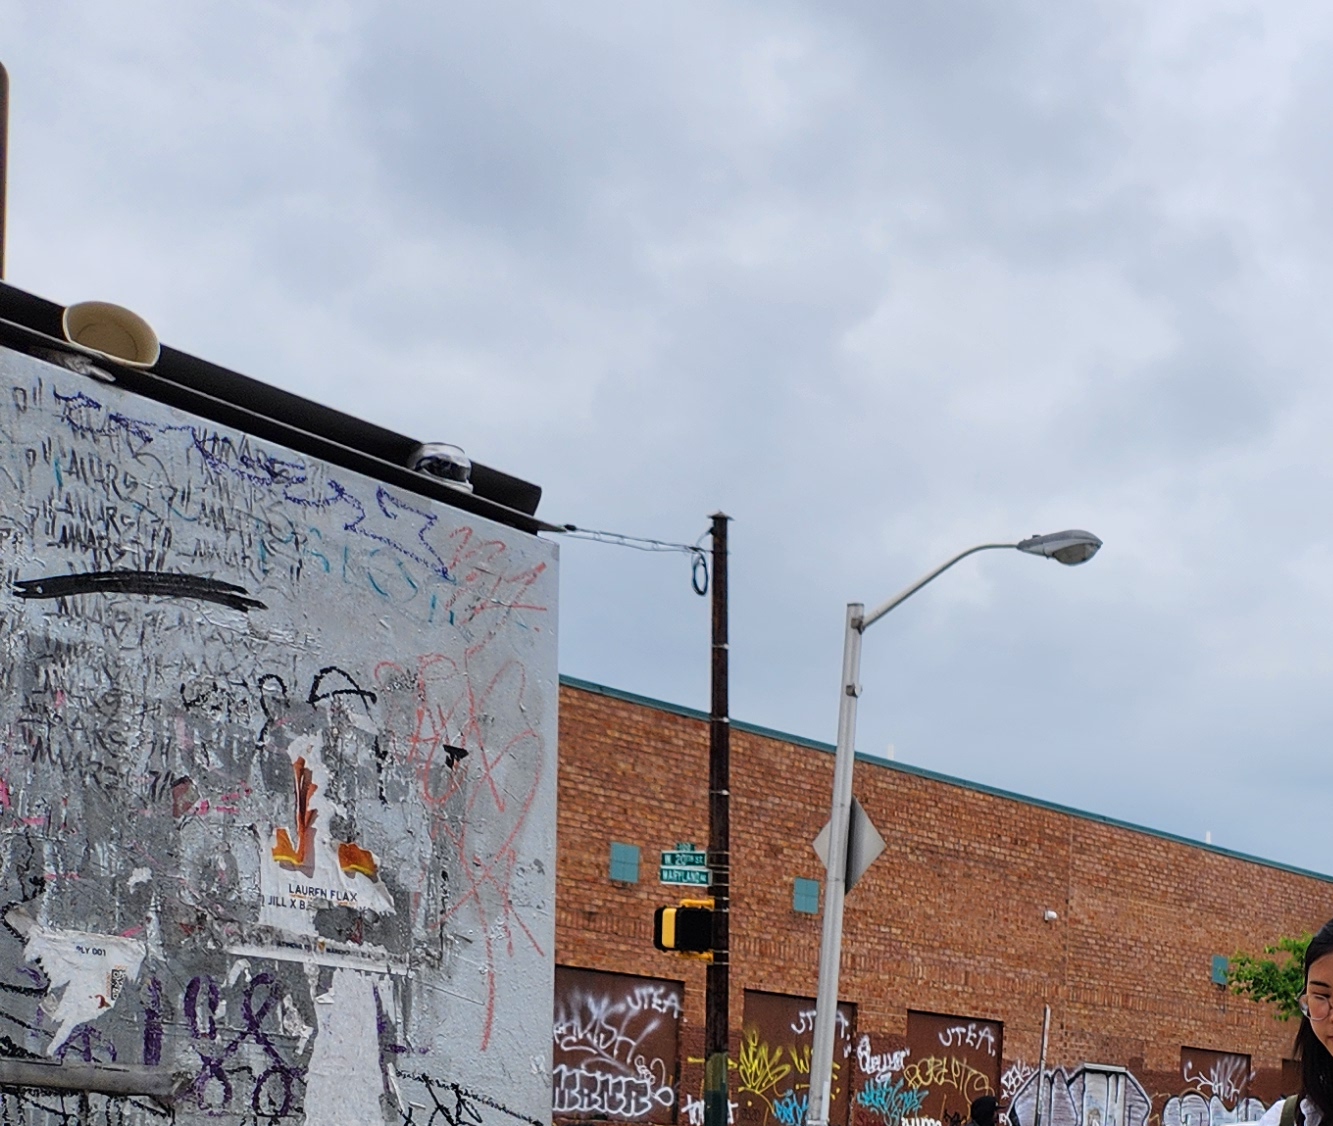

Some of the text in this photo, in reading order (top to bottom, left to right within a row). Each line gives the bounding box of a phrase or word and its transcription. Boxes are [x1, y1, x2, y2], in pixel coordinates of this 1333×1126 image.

[662, 869, 700, 883] MARYLAND
[268, 896, 287, 908] JILL
[330, 890, 358, 902] FLAX
